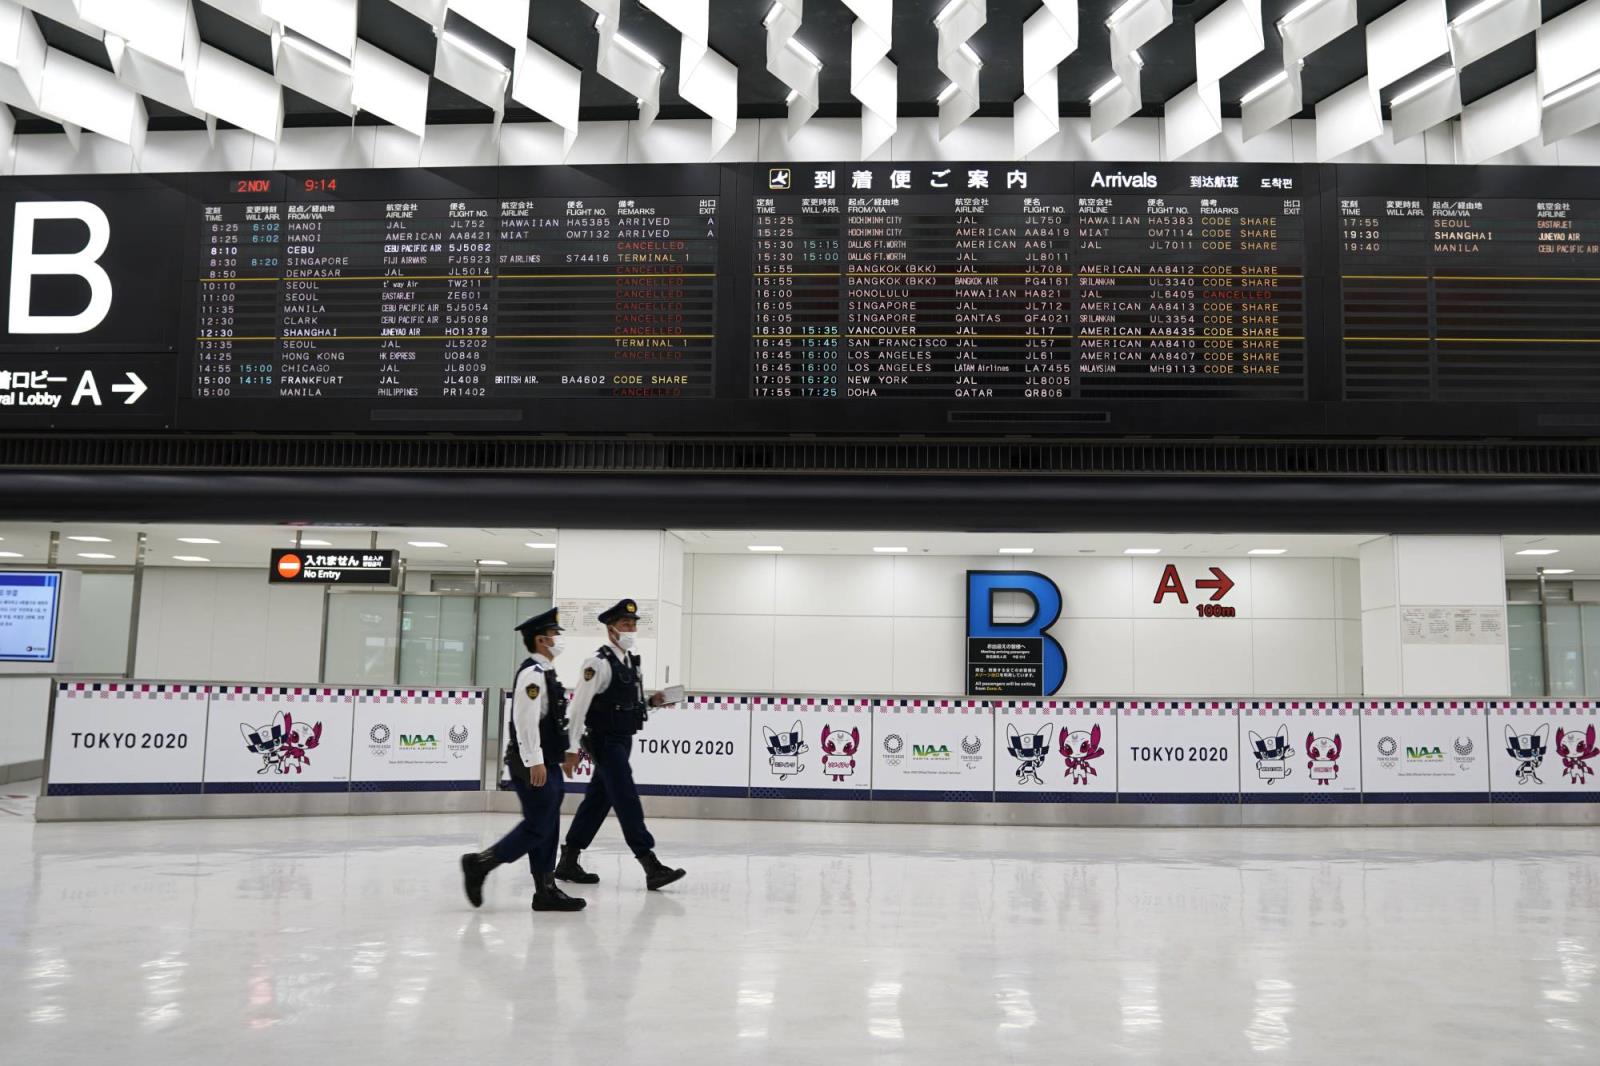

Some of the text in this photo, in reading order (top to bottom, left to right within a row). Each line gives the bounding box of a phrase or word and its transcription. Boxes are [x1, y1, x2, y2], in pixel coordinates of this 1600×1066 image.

[305, 179, 336, 191] 9:14
[814, 169, 1028, 189] 到着便ご案内
[1091, 172, 1157, 188] Arrivals
[1261, 178, 1292, 189] 도착편
[253, 223, 279, 231] 6:02
[451, 220, 484, 228] JL752
[502, 219, 559, 227] HAWAIIAN
[567, 218, 610, 226] HA5385
[886, 216, 902, 224] CITY
[1026, 216, 1061, 224] JL750
[1202, 217, 1231, 225] CODE
[1538, 221, 1571, 229] EASTARJET
[1435, 232, 1491, 240] SHANGHAI
[211, 247, 237, 255] 8:10
[288, 246, 314, 254] CEBU
[430, 244, 441, 252] AIR
[617, 241, 684, 250] CANCELLED
[1345, 243, 1598, 253] 19:40 MANILA CEBU PACIFIC AIR
[8, 201, 112, 333] B
[201, 329, 232, 337] 12:30
[802, 327, 837, 335] 15:35
[1026, 327, 1054, 335] JL17
[1080, 327, 1141, 335] AMERICAN
[1243, 328, 1278, 337] SHARE
[281, 376, 343, 384] FRANKFURT
[380, 376, 399, 384] JAL
[444, 376, 478, 384] JL408
[71, 370, 102, 405] A
[756, 388, 790, 396] 17:55
[802, 388, 836, 396] 17:25
[955, 389, 992, 397] QATAR
[1025, 389, 1062, 397] QR806
[19, 392, 61, 407] Lobby
[305, 555, 359, 566] 入れません
[304, 570, 340, 580] No Entry
[1153, 564, 1188, 604] A
[1196, 604, 1235, 617] 100m
[966, 570, 1067, 695] B
[72, 733, 187, 748] TOKYO 2020
[400, 735, 437, 746] NAA
[639, 739, 733, 755] TOKYO 2020
[913, 745, 950, 757] NAA
[1407, 747, 1443, 758] NAA
[1131, 747, 1227, 761] TOKYO 2020
